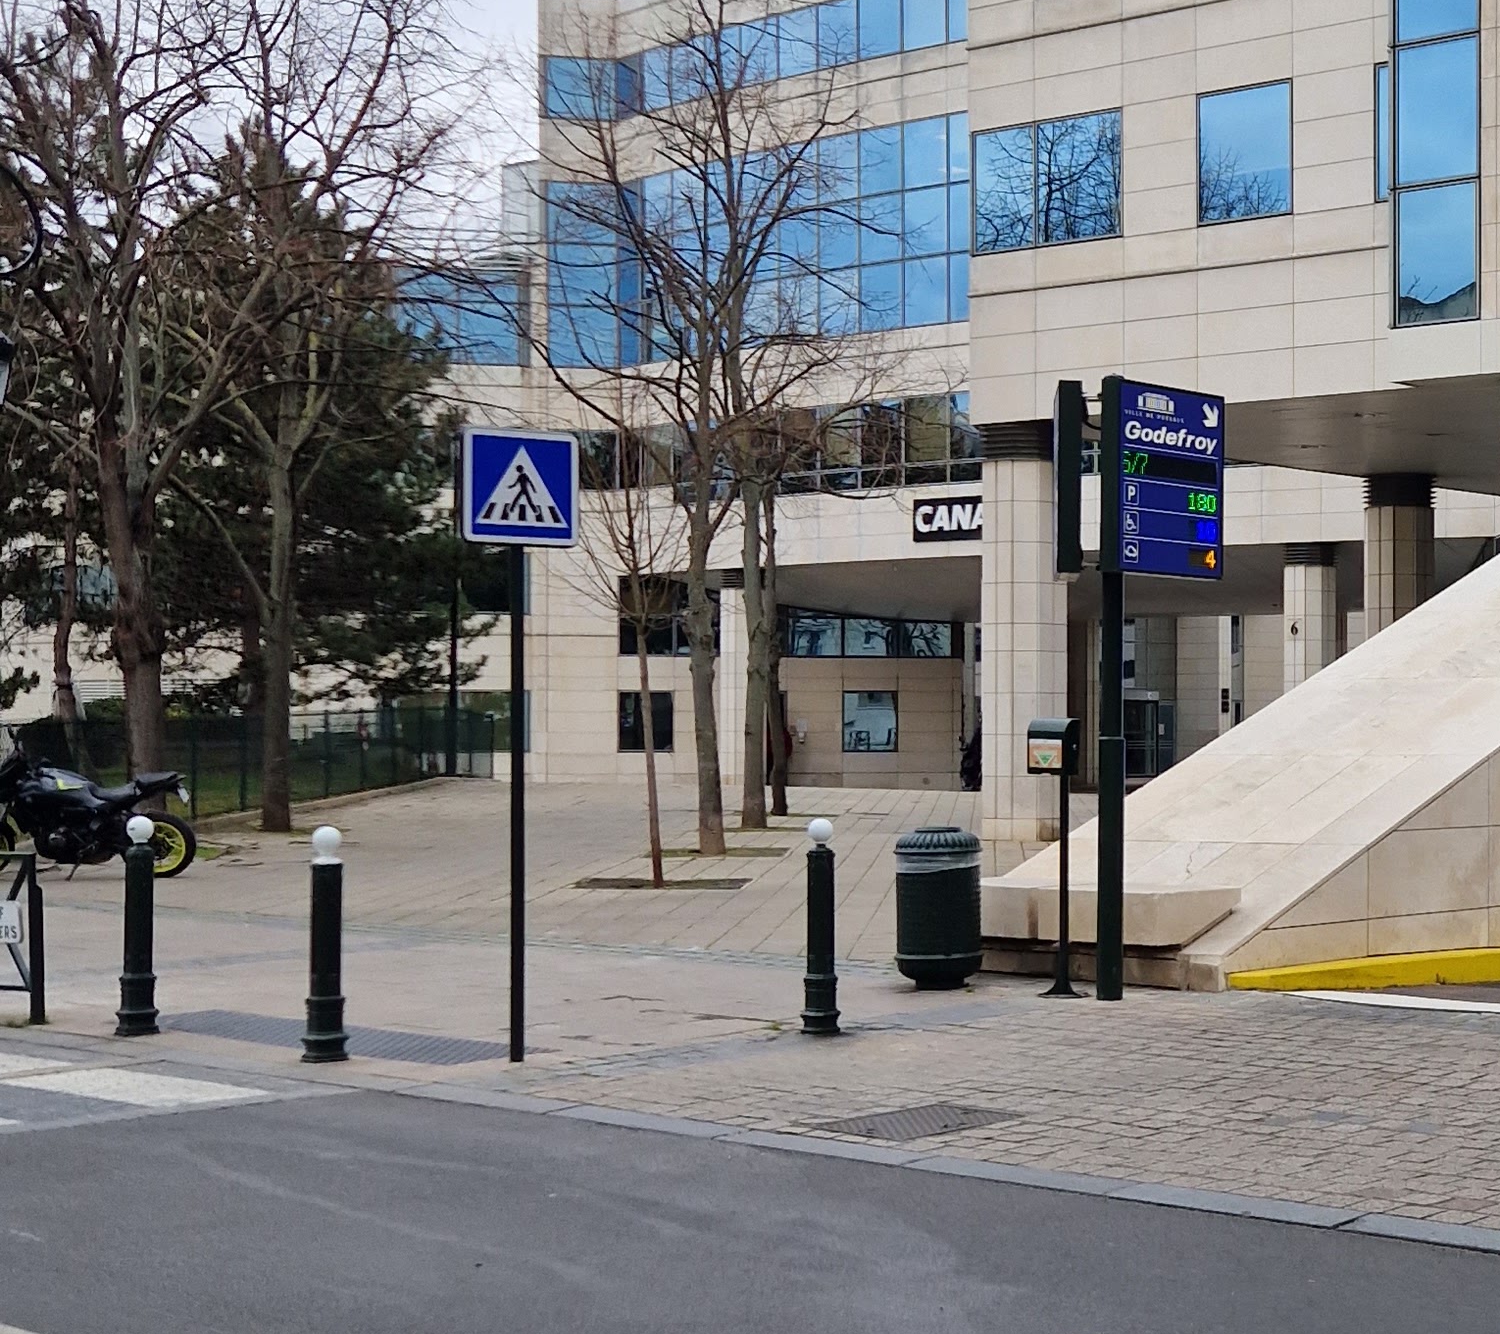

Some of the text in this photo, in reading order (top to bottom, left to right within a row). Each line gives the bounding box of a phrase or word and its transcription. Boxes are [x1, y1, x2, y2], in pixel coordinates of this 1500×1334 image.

[1125, 421, 1218, 455] Godefroy
[1188, 493, 1216, 513] 180
[1205, 550, 1216, 569] 4
[1290, 621, 1299, 636] 6
